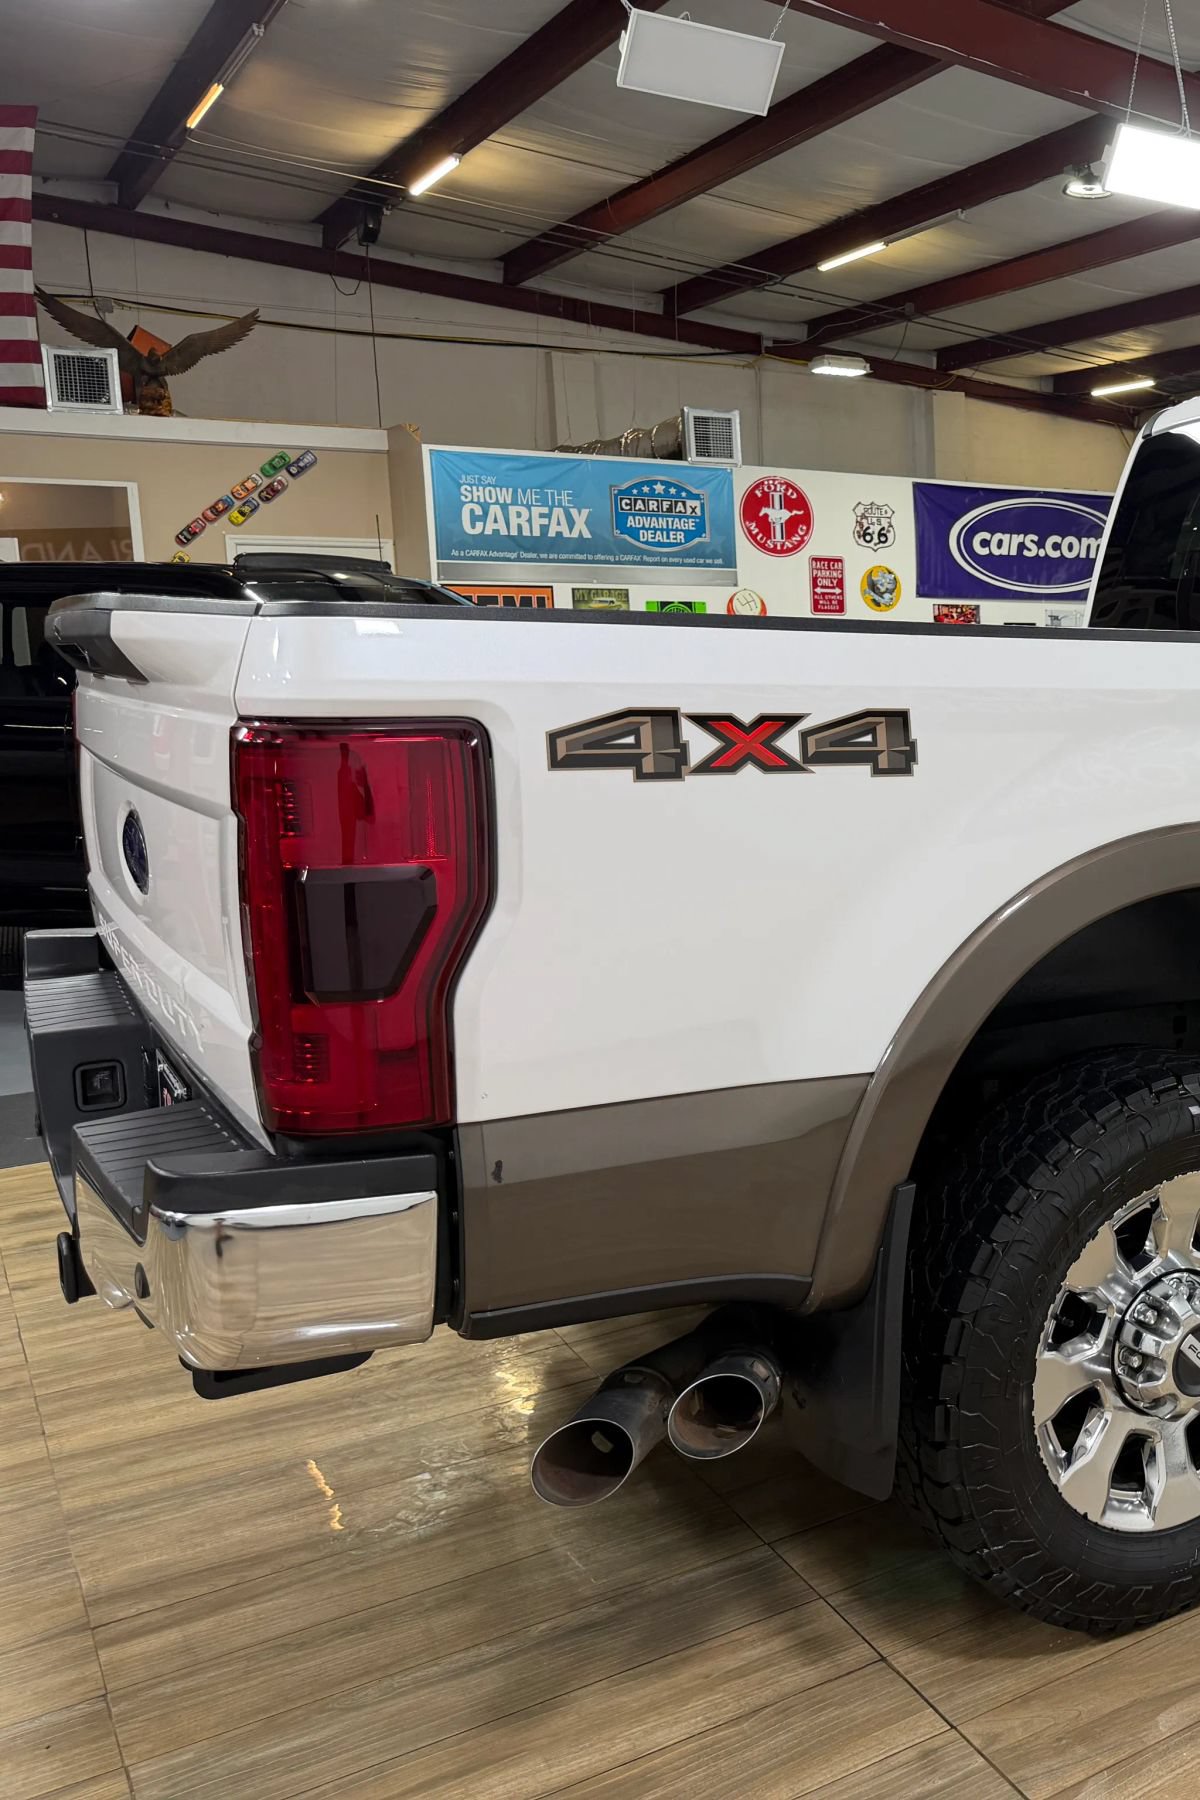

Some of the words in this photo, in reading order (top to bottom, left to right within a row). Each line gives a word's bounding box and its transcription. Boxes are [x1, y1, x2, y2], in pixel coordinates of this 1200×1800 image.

[460, 475, 479, 484] JUST
[481, 475, 497, 485] SAY
[460, 485, 513, 504] SHOW
[518, 488, 542, 505] ME
[544, 489, 575, 507] THE
[755, 480, 798, 499] FORD
[620, 498, 699, 516] CARFAX
[863, 507, 884, 516] ROUTE
[461, 503, 593, 539] CARFAX
[626, 516, 697, 530] ADVANTAGE
[639, 529, 686, 543] DEALER
[745, 520, 808, 550] MUSTANG
[863, 526, 889, 544] 66
[972, 531, 1103, 559] cars.com
[465, 549, 489, 558] CARFAX
[812, 561, 829, 569] RACE
[830, 561, 843, 570] CAR
[812, 569, 843, 578] PARKING
[816, 578, 839, 586] ONLY
